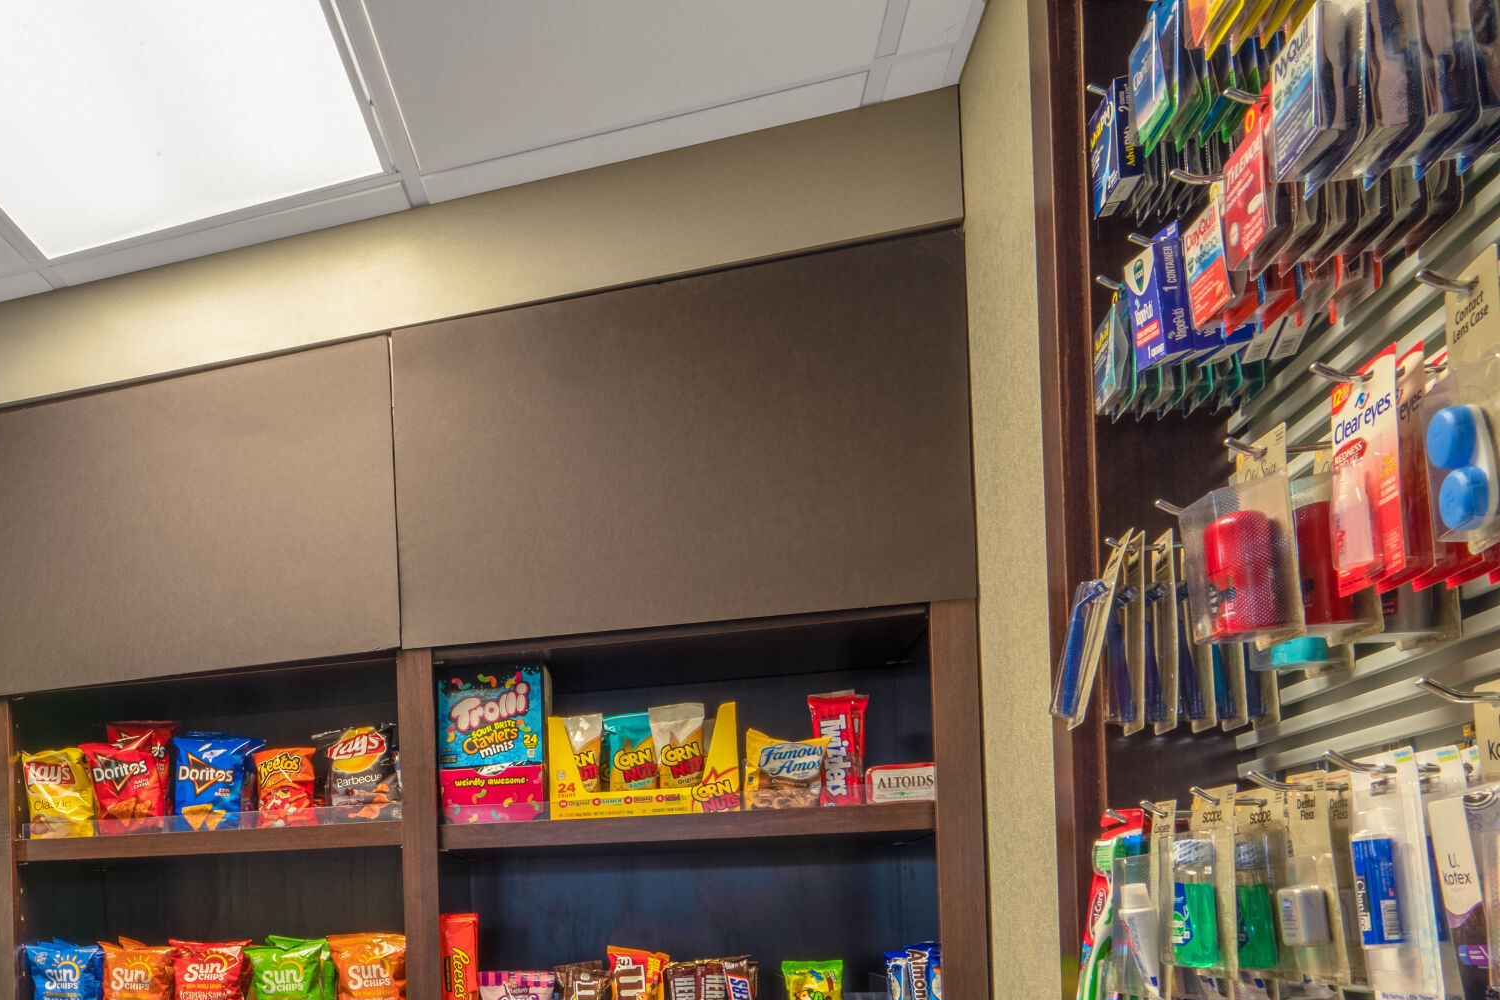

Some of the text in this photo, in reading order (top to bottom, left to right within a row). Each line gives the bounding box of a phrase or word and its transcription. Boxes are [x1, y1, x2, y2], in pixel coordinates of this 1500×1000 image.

[1274, 16, 1309, 85] NyQuil
[1185, 206, 1216, 252] DayQuil
[1164, 246, 1173, 283] CONTAINER
[1455, 291, 1484, 325] Contact
[1452, 304, 1489, 344] Lens Case
[1334, 393, 1391, 445] Clear eyes
[1334, 441, 1363, 467] REDNESS
[451, 682, 529, 731] Trolli
[471, 719, 516, 739] SOUR BRITE
[523, 734, 538, 745] 24
[332, 734, 380, 760] Lay's
[462, 728, 518, 755] Crawlers
[480, 741, 514, 759] minis
[614, 748, 652, 770] CORN
[661, 742, 700, 767] CORN
[759, 744, 824, 767] Famous
[27, 762, 71, 785] Lay's
[93, 760, 148, 783] Doritos
[178, 765, 234, 783] Doritos
[771, 757, 821, 776] Amos
[336, 772, 382, 788] Barbecue
[454, 777, 526, 788] weirdly awesome
[558, 783, 576, 793] 24
[692, 779, 732, 802] CORN
[877, 774, 934, 790] ALTOIDS
[703, 794, 740, 812] NUTS
[1297, 796, 1316, 809] Dental
[1300, 810, 1315, 821] Floss
[1443, 870, 1472, 885] kotex
[45, 967, 78, 990] Sun
[111, 967, 150, 991] Sun
[184, 962, 225, 982] Sun
[197, 973, 225, 981] CHIPS
[261, 969, 304, 994] Sun
[348, 964, 390, 990] Sun
[363, 979, 390, 987] CHIPS
[452, 947, 470, 1000] Reese's
[124, 983, 150, 991] CHIPS
[277, 983, 304, 992] CHIPS
